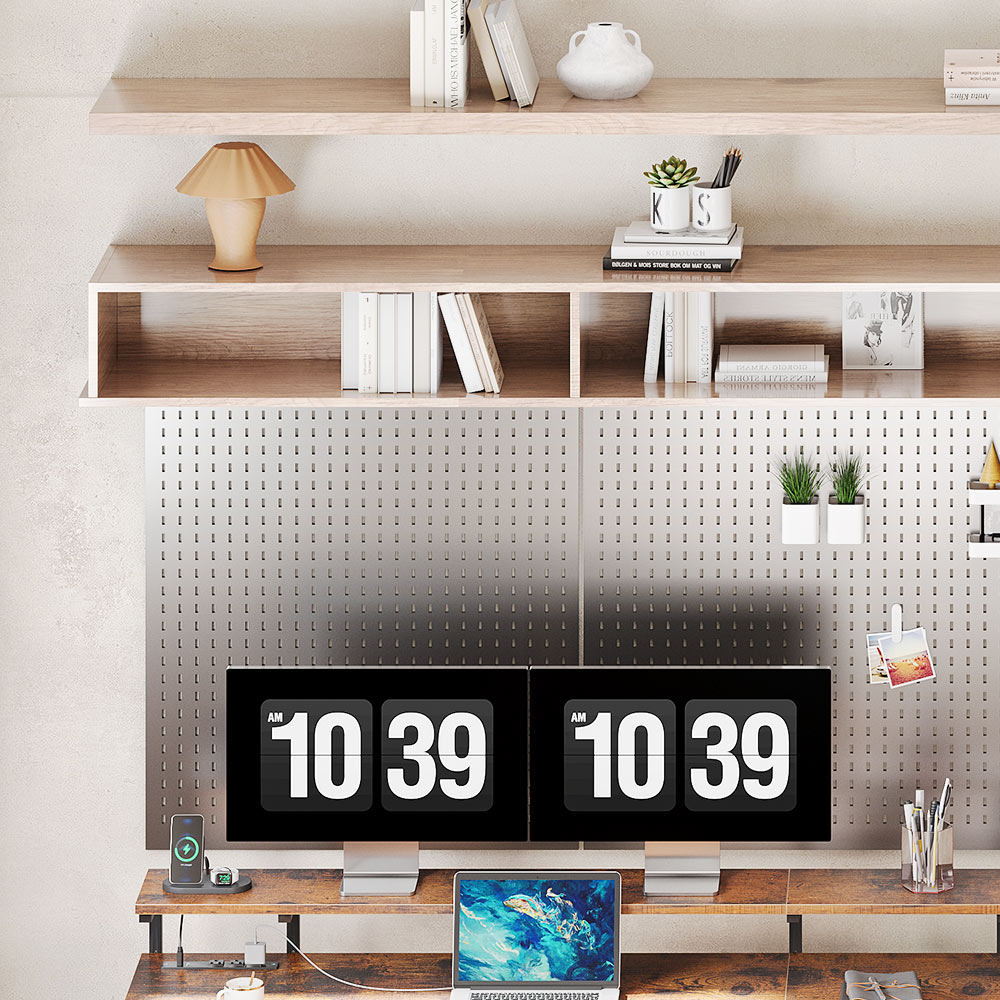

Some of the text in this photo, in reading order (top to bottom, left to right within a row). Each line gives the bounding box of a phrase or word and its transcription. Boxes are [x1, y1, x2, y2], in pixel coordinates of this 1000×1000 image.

[450, 28, 459, 68] MICHAEL
[450, 70, 459, 80] IS
[450, 82, 459, 108] WHO
[652, 192, 663, 226] K
[697, 193, 711, 226] S
[267, 712, 283, 723] AM
[570, 712, 587, 723] AM
[271, 711, 487, 800] 10 39
[574, 711, 790, 800] 10 39
